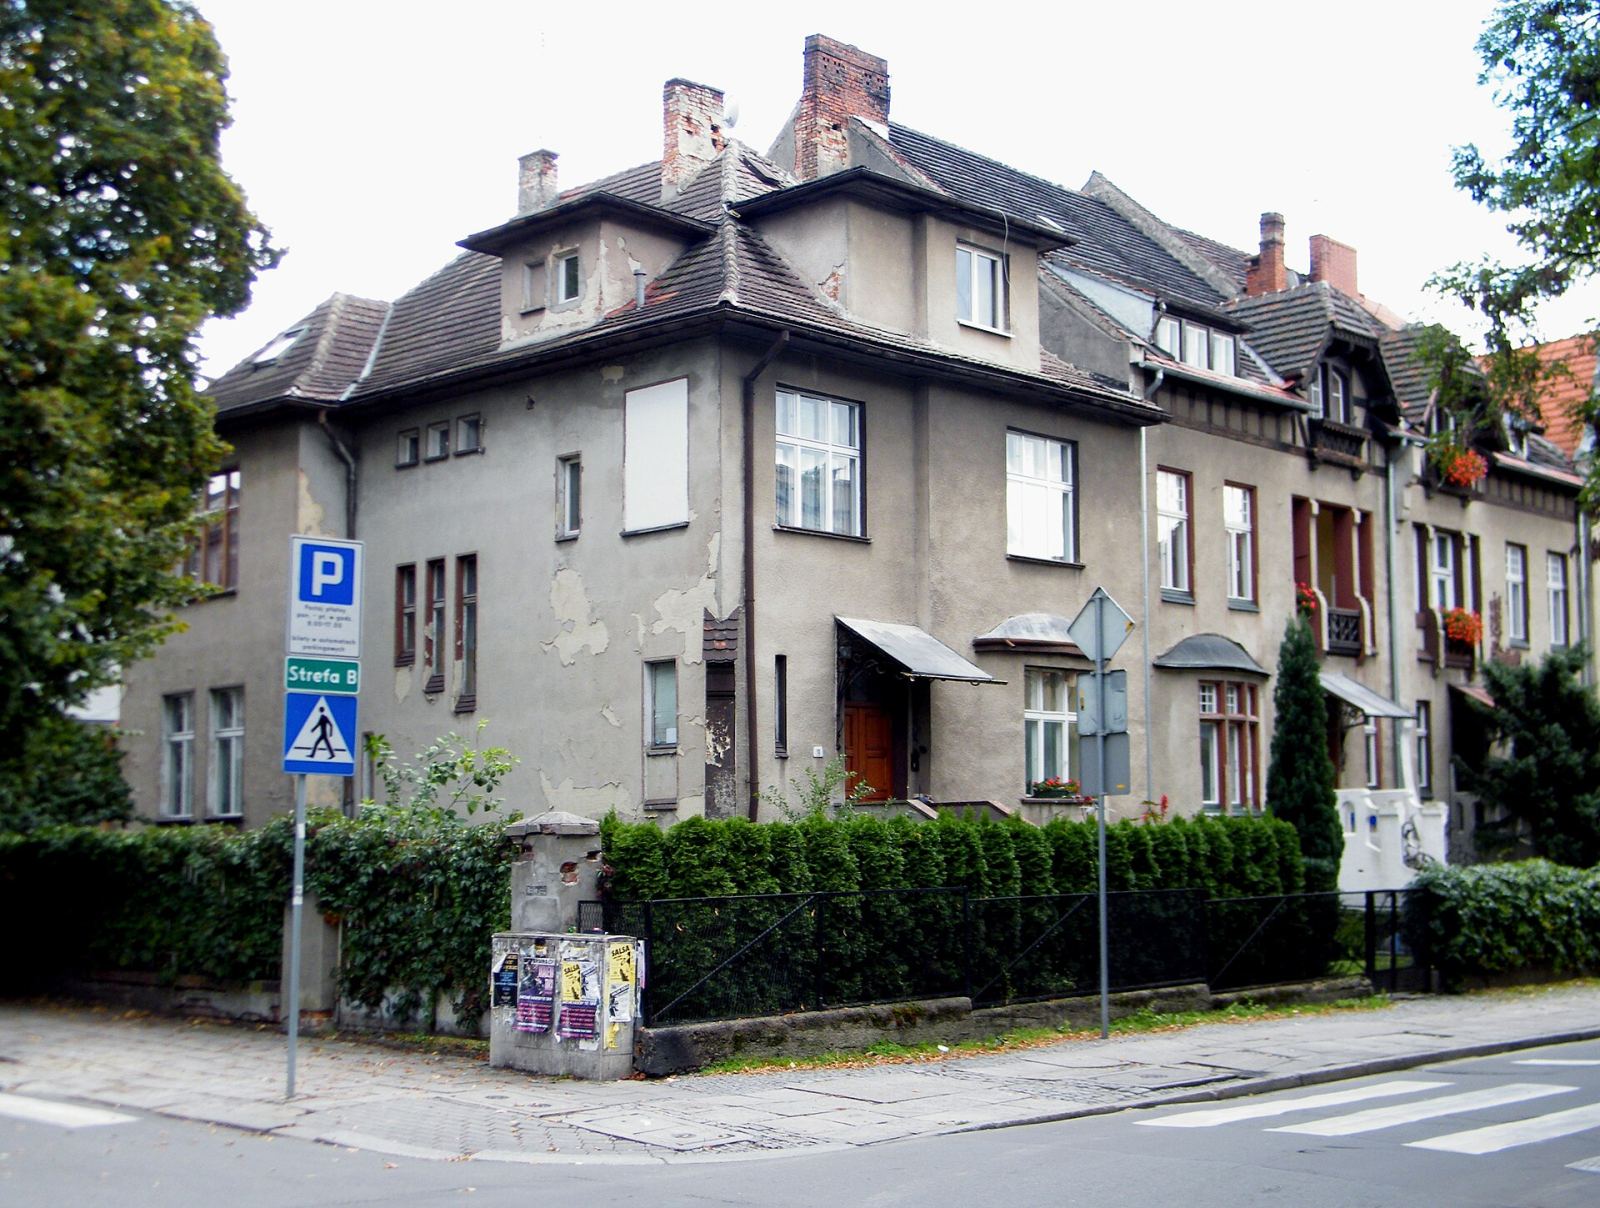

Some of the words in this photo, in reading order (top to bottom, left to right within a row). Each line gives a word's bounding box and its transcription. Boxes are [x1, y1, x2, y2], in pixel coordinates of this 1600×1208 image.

[312, 551, 344, 596] P
[289, 665, 340, 683] Strefa
[346, 669, 357, 685] B
[611, 945, 630, 957] SALSA
[563, 964, 580, 975] SALSA
